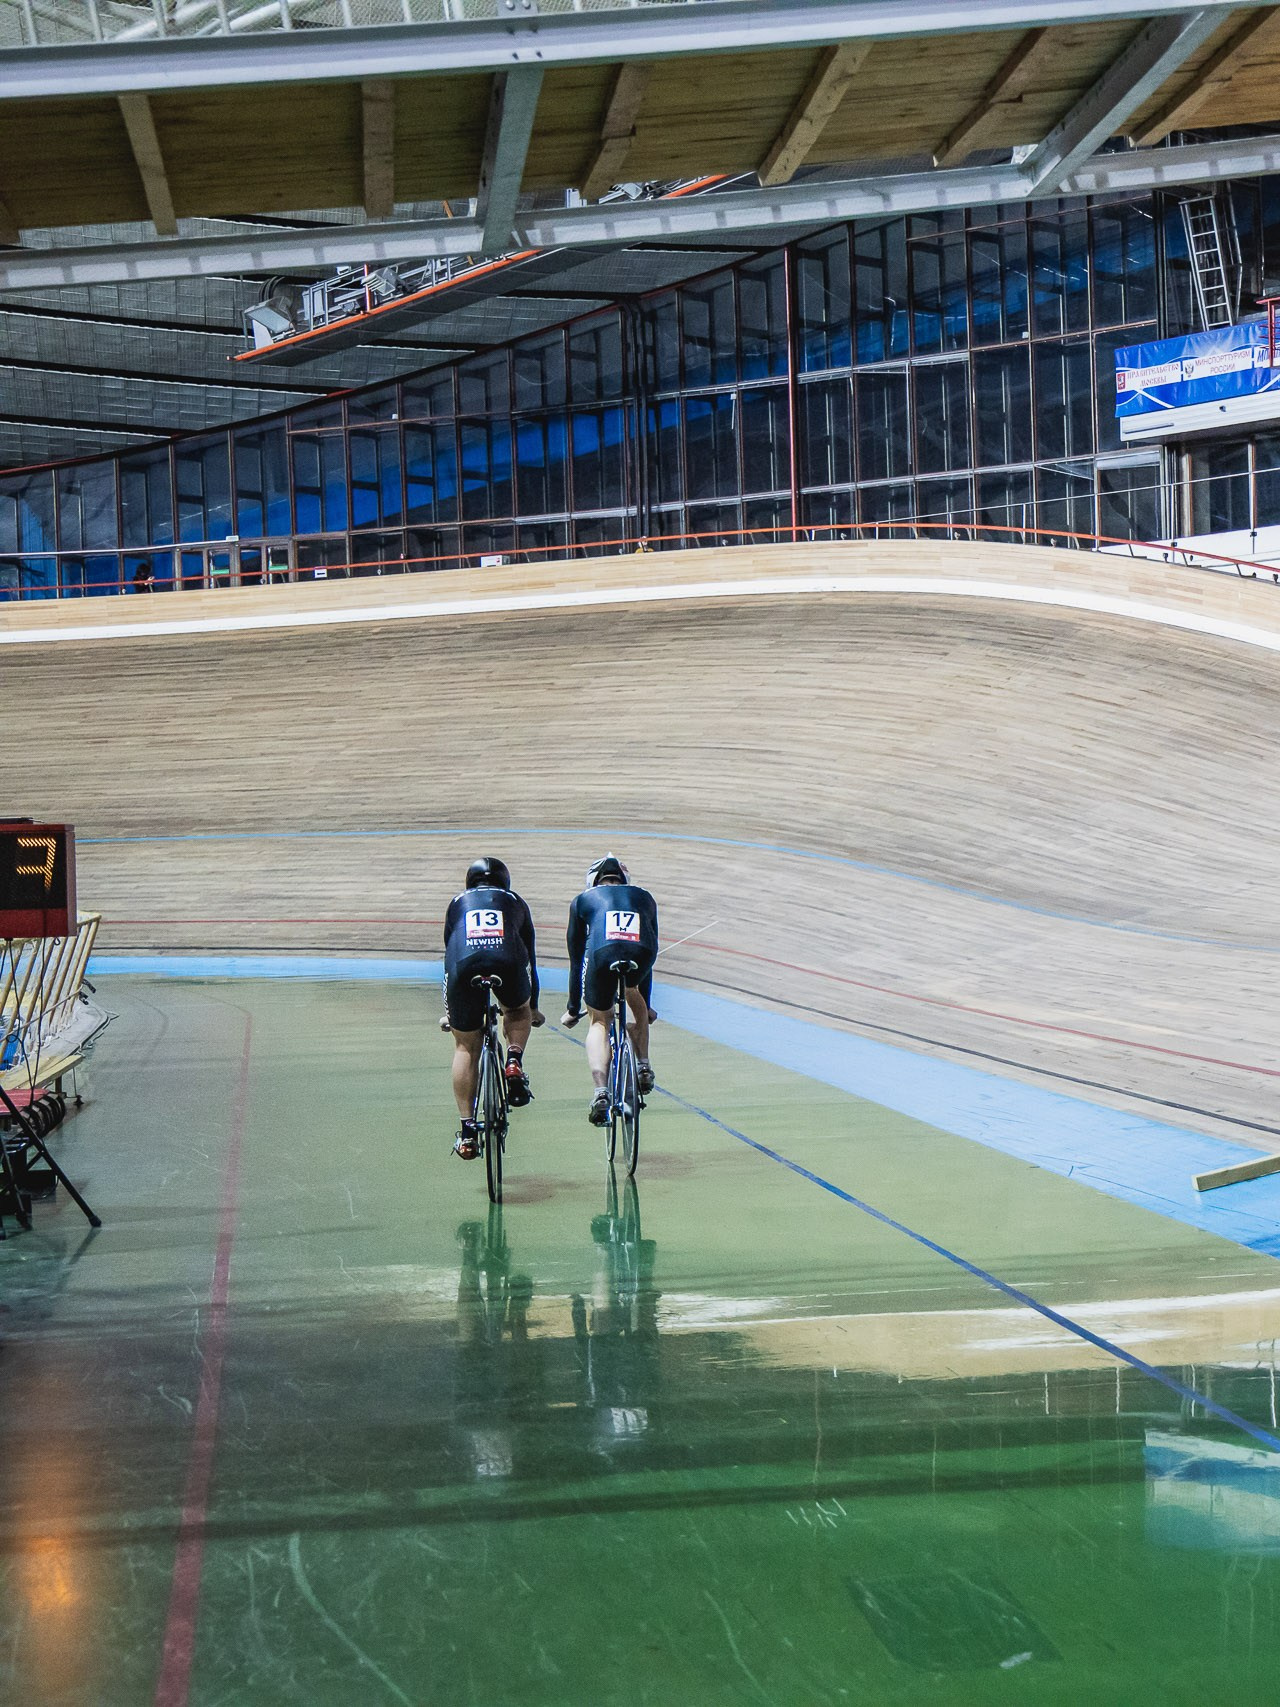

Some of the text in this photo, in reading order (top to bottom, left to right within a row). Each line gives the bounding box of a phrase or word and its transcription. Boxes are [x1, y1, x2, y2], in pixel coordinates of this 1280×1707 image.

[1194, 350, 1250, 366] МИНСПОРТТУРИЗМ
[1127, 363, 1179, 379] ПРАВИТЕЛЬСТВО
[1210, 362, 1236, 374] РОССИИ
[1140, 375, 1167, 387] МОСКВЫ
[471, 912, 499, 927] 13
[612, 912, 635, 927] 17
[466, 937, 503, 946] NEWISH
